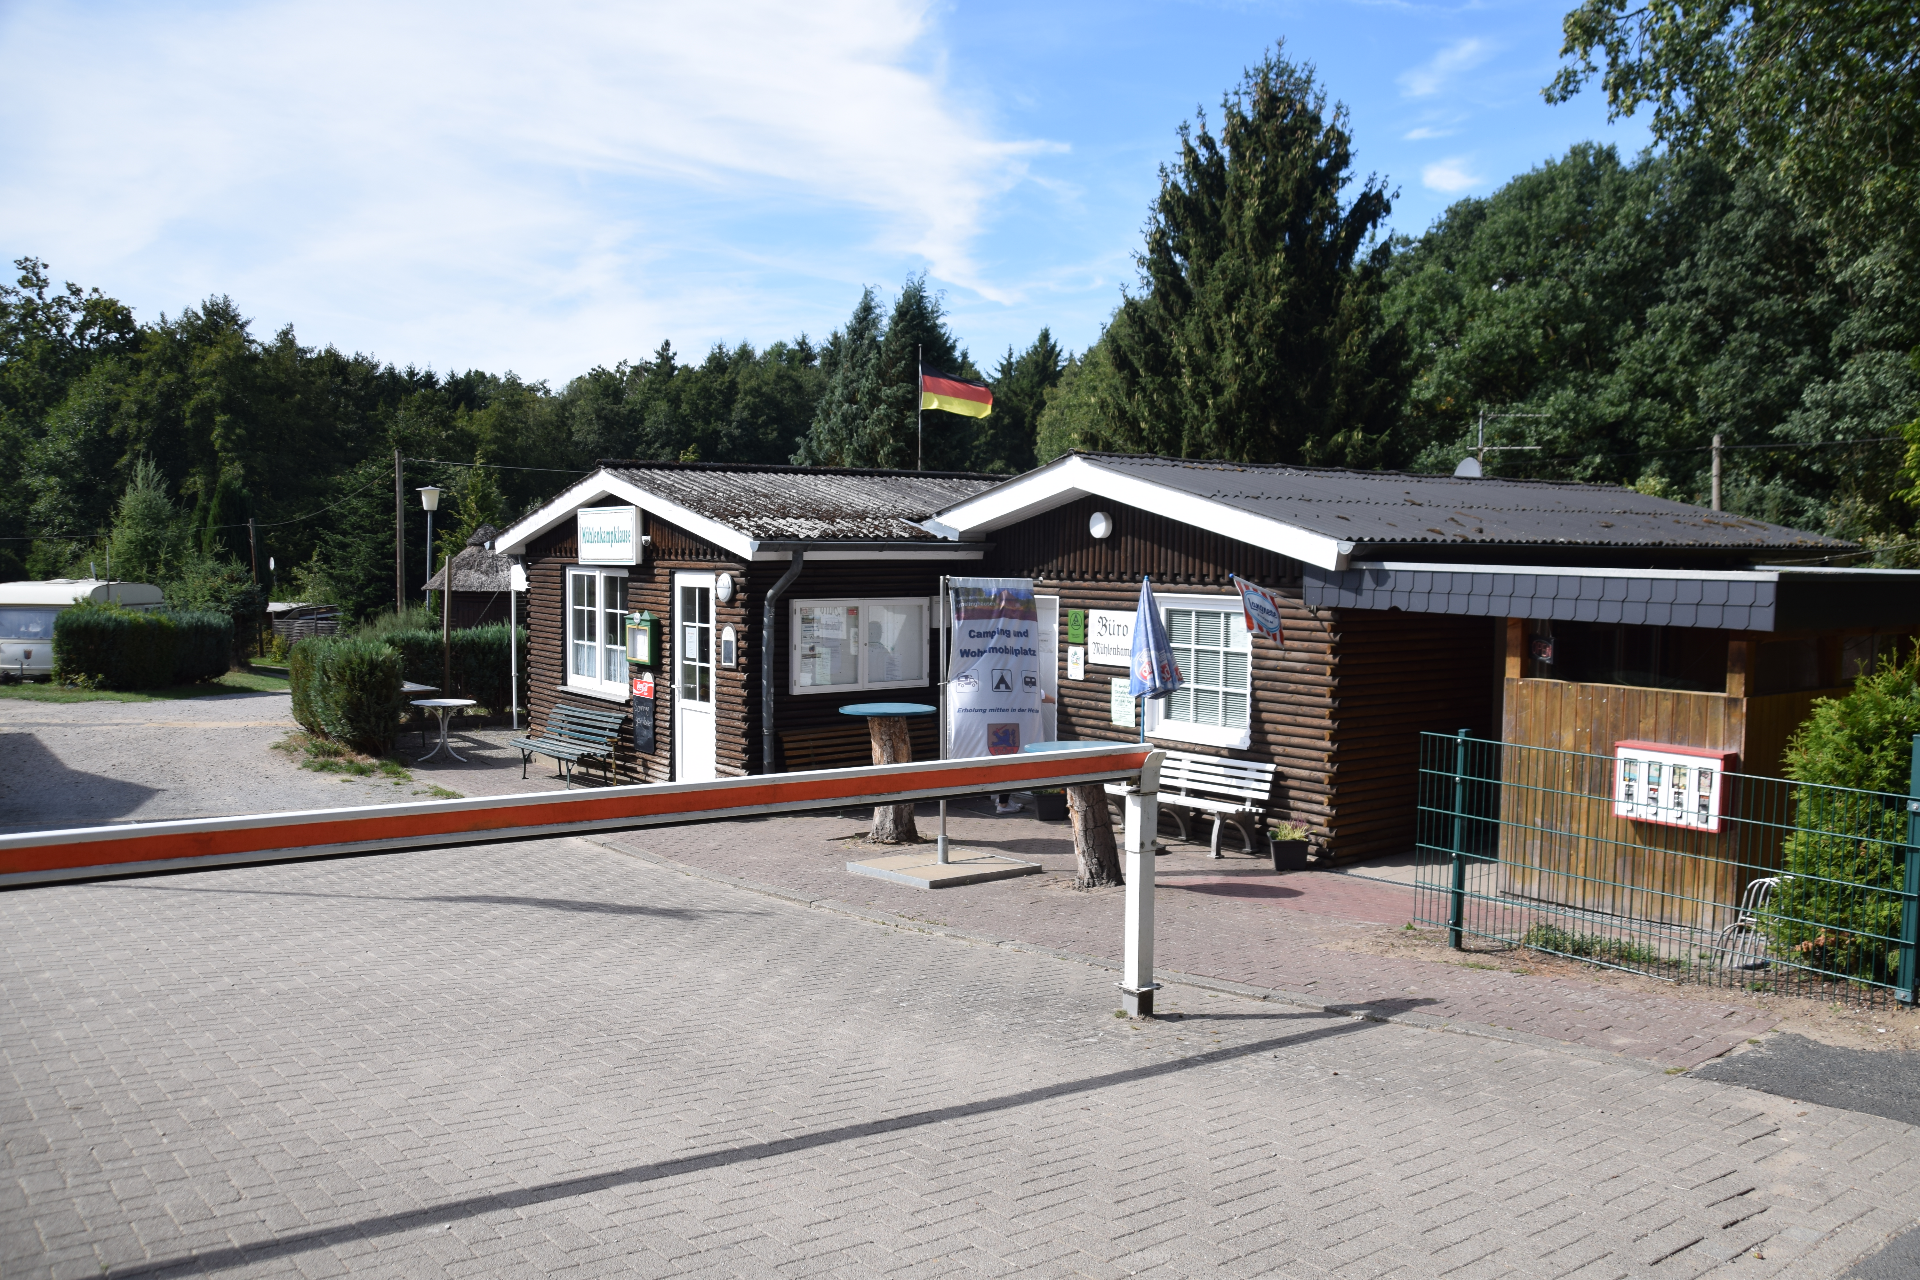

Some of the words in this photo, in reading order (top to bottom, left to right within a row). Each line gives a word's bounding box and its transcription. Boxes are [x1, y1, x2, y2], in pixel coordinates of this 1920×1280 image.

[581, 526, 631, 548] Mühlenkampklause
[1247, 597, 1278, 620] Langnese
[968, 627, 1011, 639] Camping
[1013, 629, 1029, 638] und
[1096, 615, 1129, 637] Büro
[957, 706, 987, 714] Erholung
[988, 706, 1010, 714] mitten
